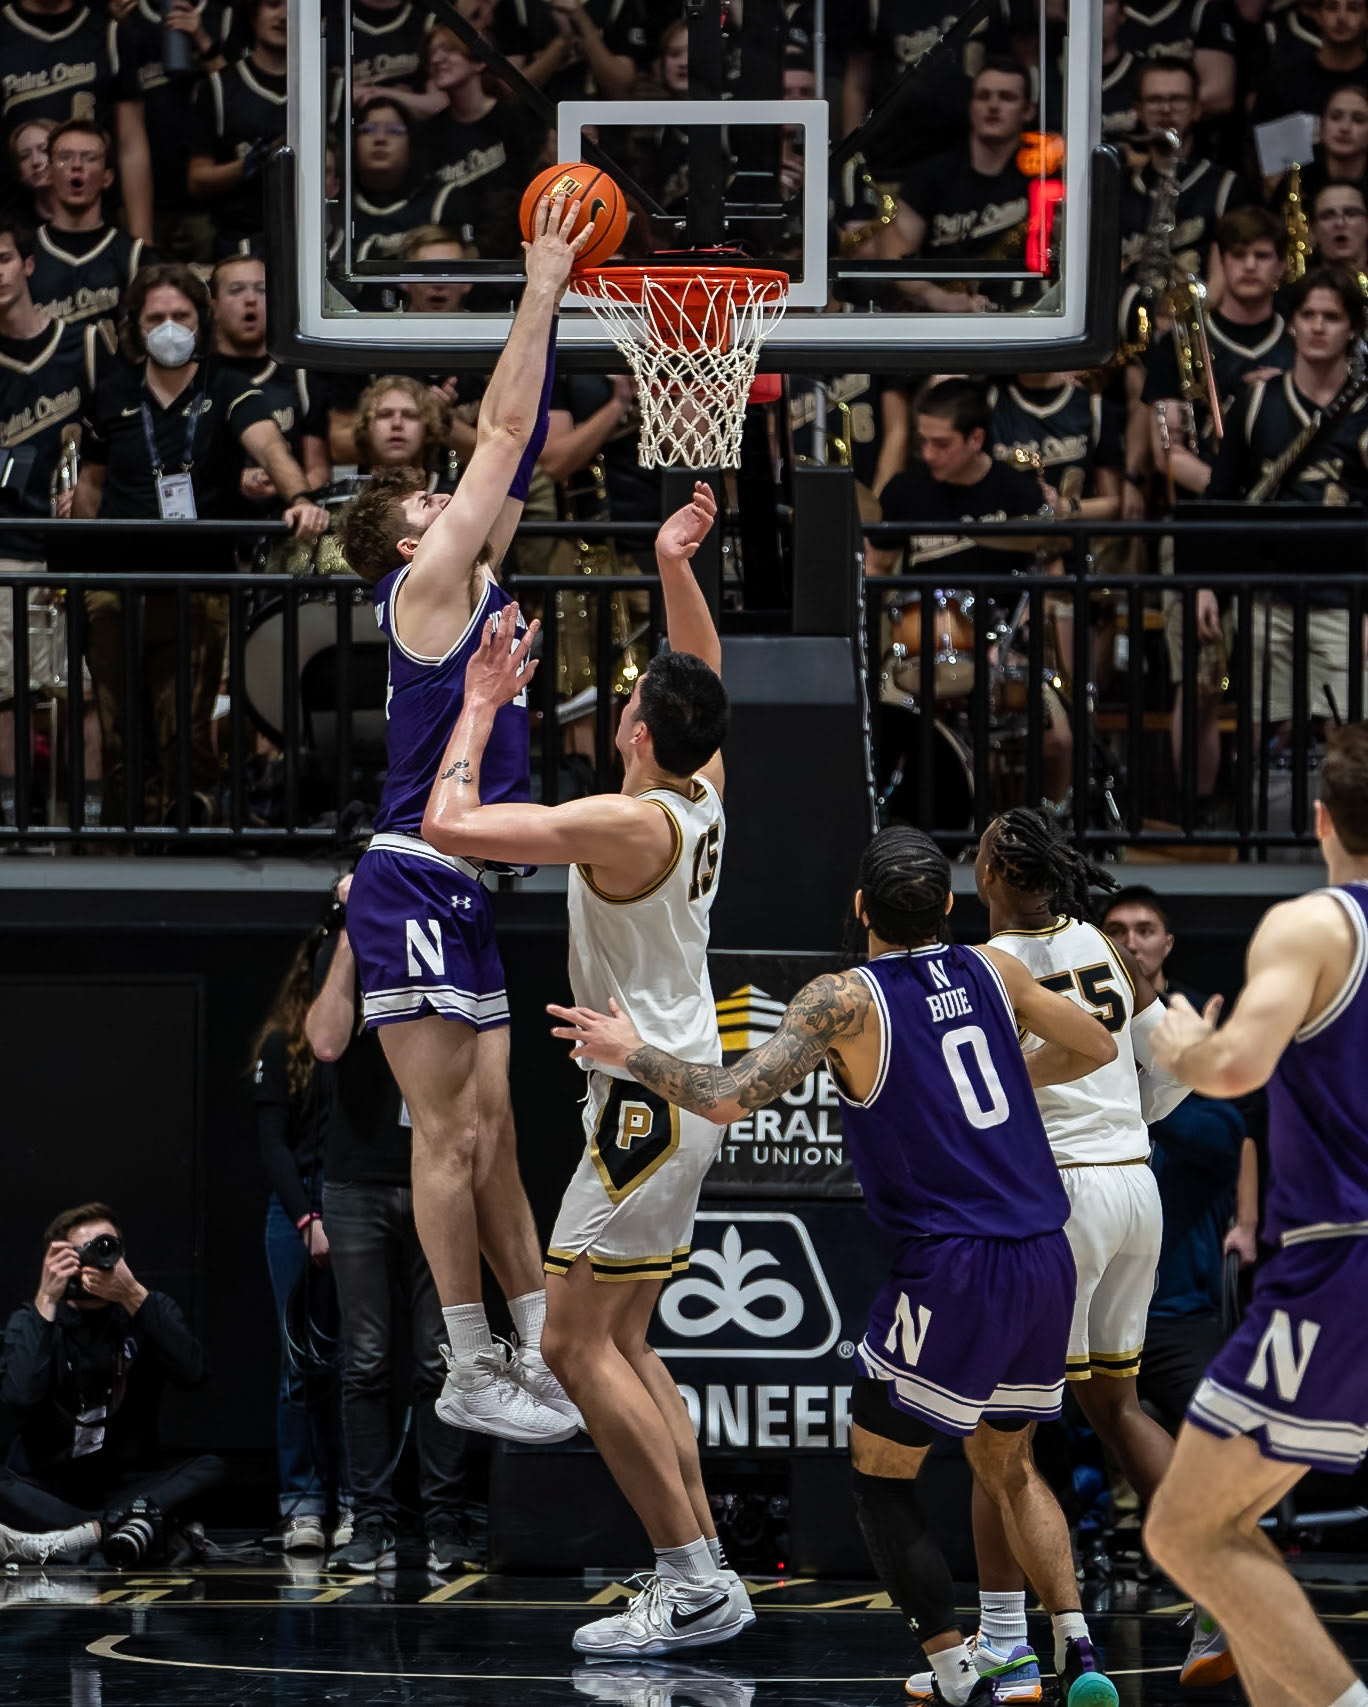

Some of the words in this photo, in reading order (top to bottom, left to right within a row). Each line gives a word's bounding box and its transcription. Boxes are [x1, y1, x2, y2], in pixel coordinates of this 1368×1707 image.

[688, 822, 720, 901] 15
[405, 918, 445, 977] N
[926, 959, 953, 989] N
[926, 987, 973, 1023] BUIE
[942, 1024, 1010, 1130] 0
[615, 1100, 654, 1150] P
[752, 1146, 843, 1165] UNION
[884, 1290, 932, 1367] N
[1245, 1309, 1321, 1403] N
